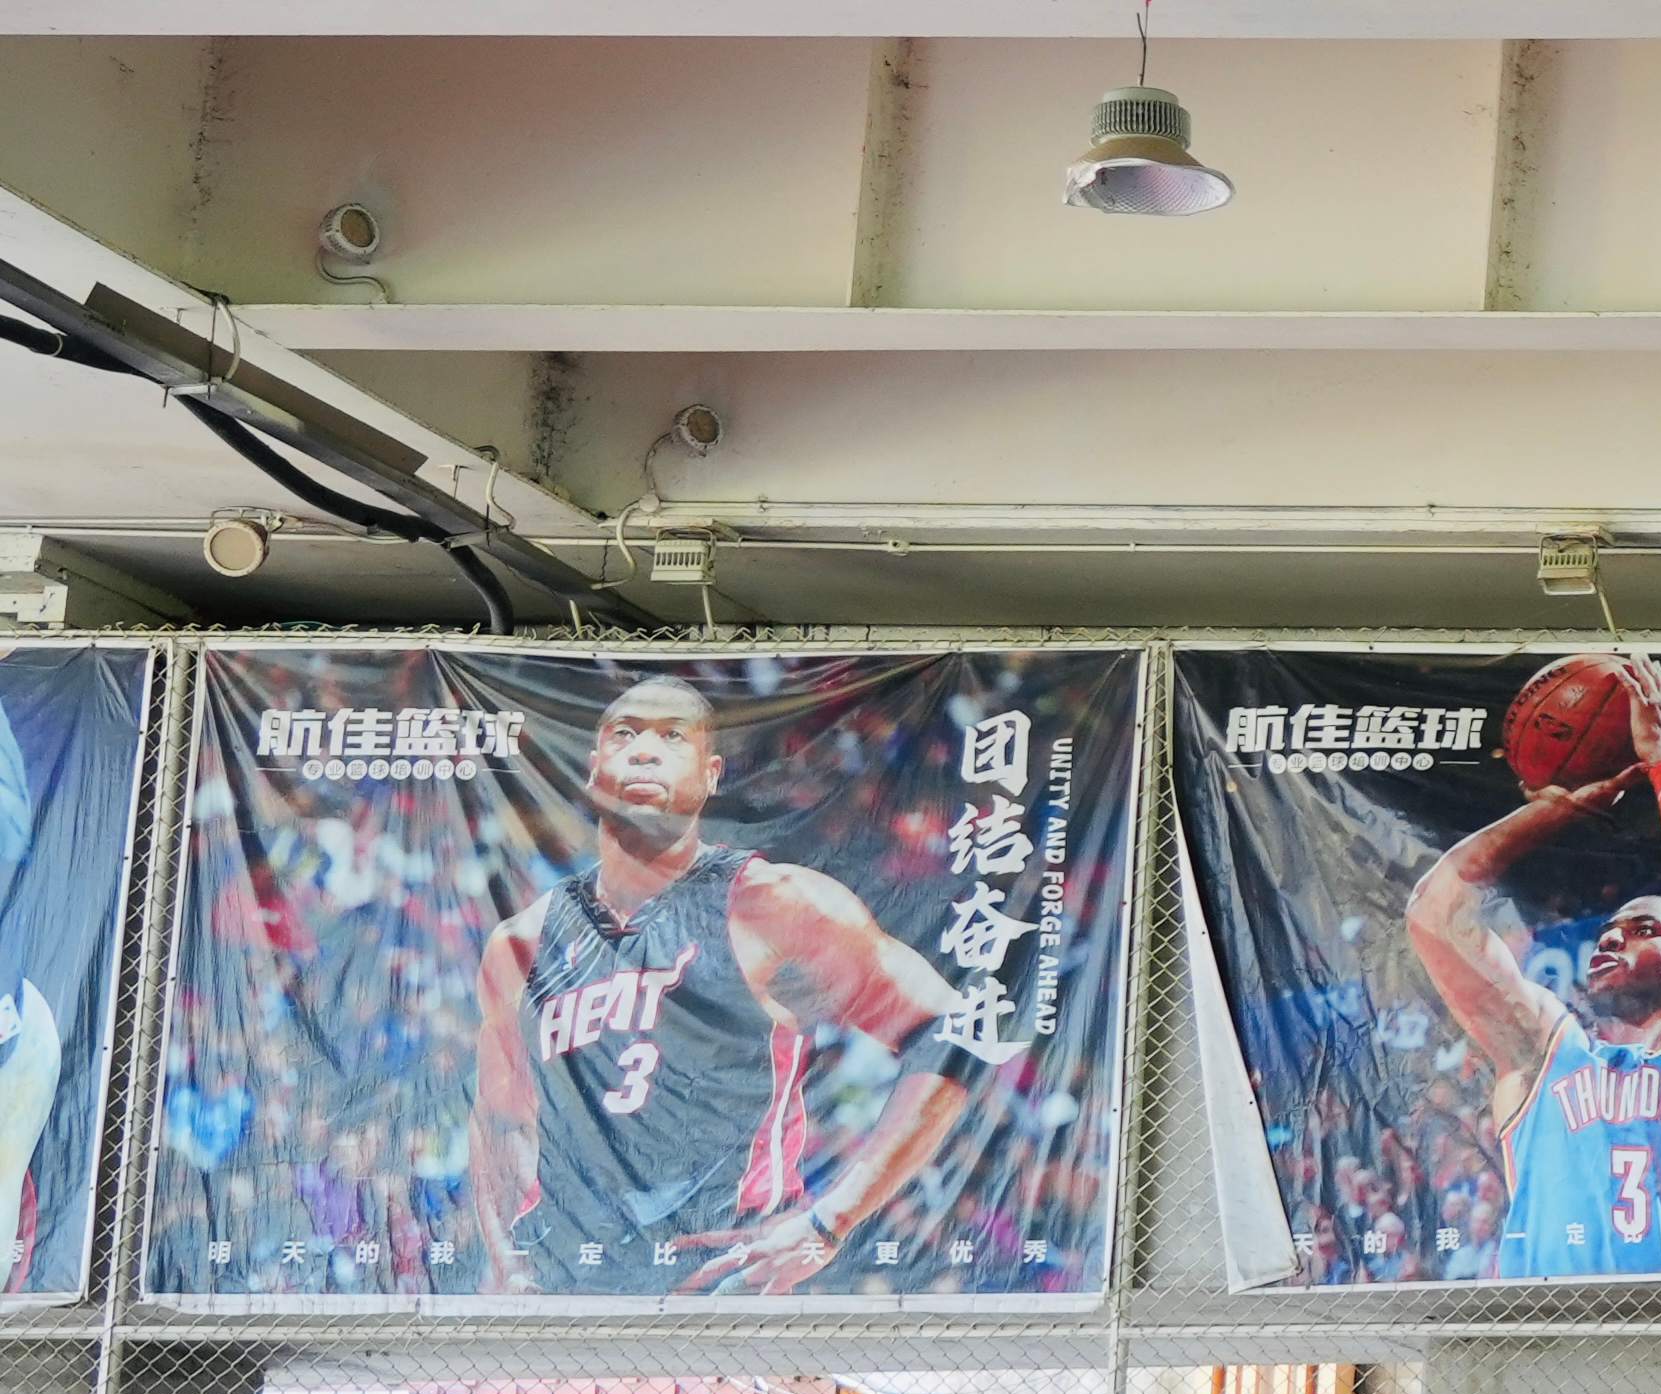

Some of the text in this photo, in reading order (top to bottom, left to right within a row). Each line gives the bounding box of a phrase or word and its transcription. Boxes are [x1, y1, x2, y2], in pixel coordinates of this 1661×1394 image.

[256, 707, 524, 757] 航佳篮球
[1226, 705, 1488, 753] 航佳篮球
[1268, 752, 1434, 775] 专业篮球培训中心
[302, 759, 476, 780] 专业篮球培训中心
[933, 709, 1042, 1065] 团结奋进
[1033, 737, 1073, 1036] UNITY AND FORGE AHEAD
[541, 941, 697, 1062] HEAT
[601, 1040, 660, 1114] 3
[1608, 1144, 1652, 1240] 3
